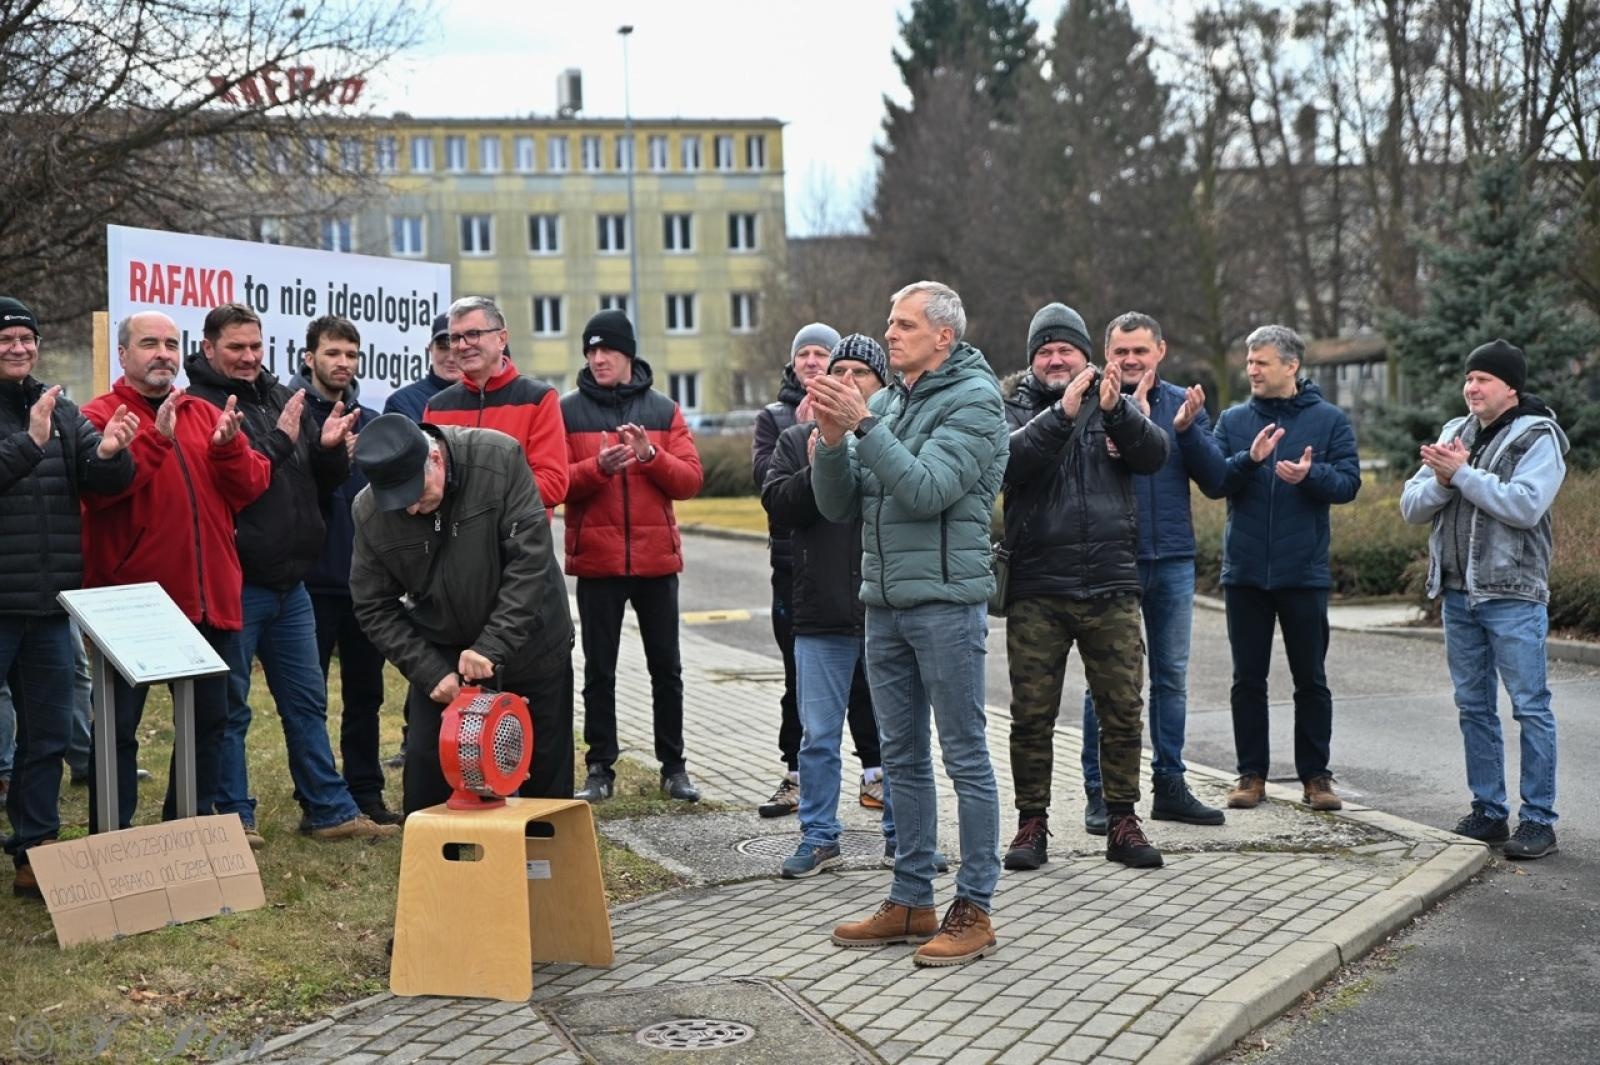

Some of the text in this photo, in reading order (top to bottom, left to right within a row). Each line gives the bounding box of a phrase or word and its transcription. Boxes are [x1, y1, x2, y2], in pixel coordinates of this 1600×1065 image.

[130, 261, 437, 332] RAFAKO to nie ideologia!
[287, 339, 429, 388] teologia!
